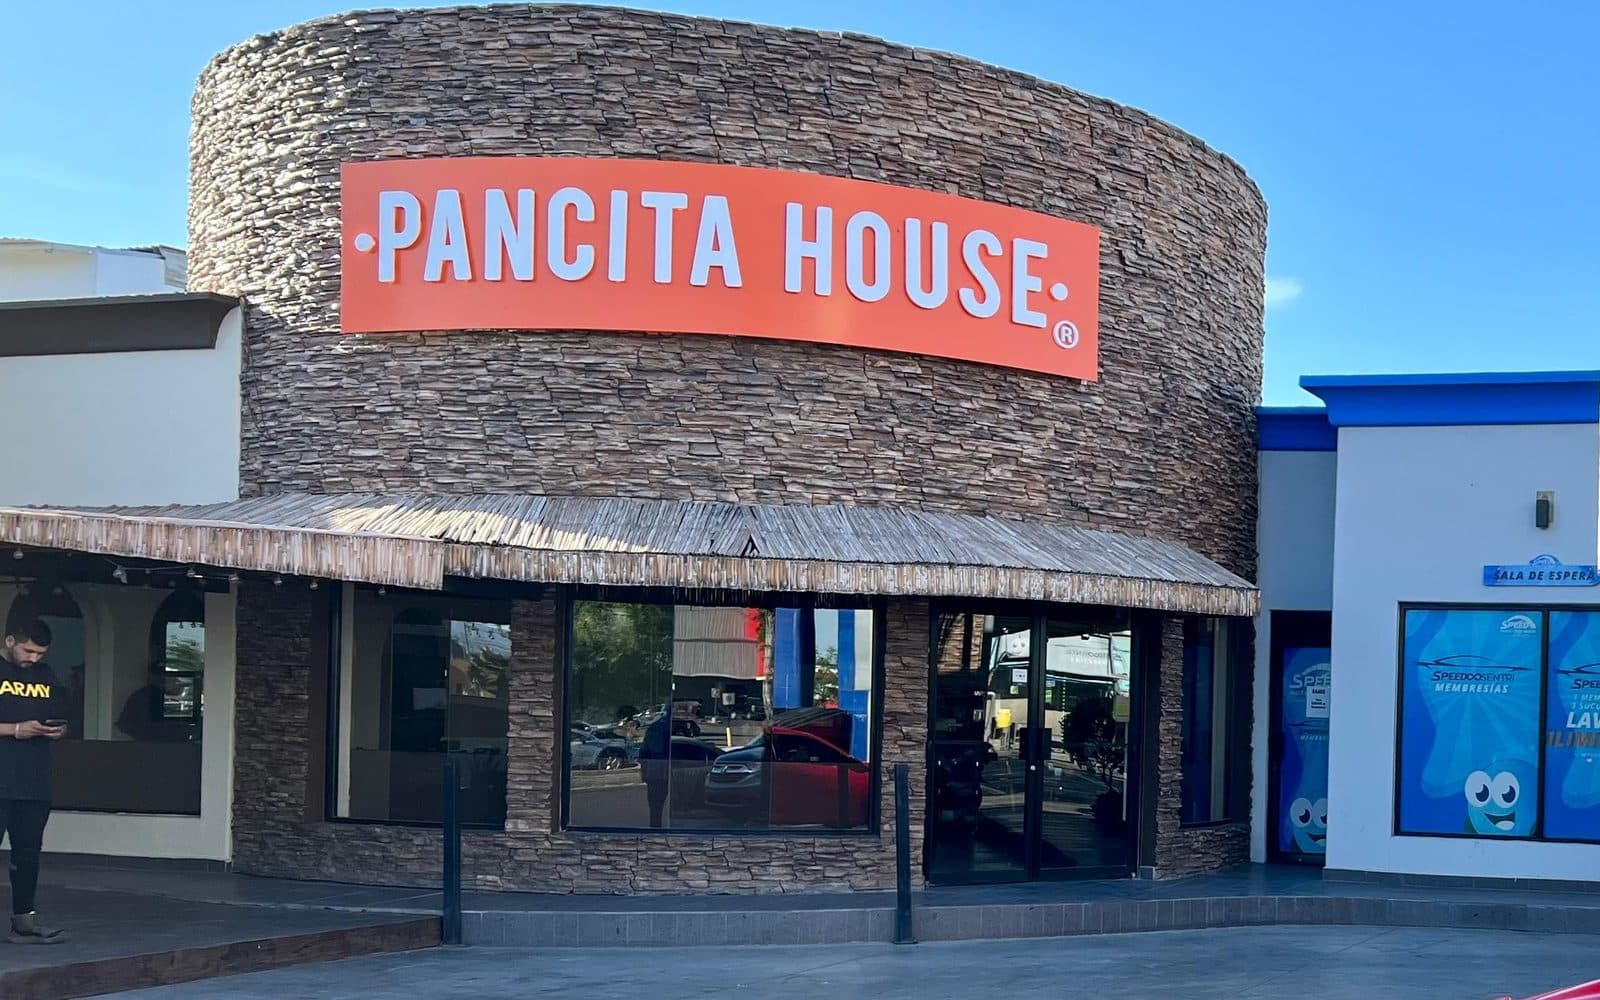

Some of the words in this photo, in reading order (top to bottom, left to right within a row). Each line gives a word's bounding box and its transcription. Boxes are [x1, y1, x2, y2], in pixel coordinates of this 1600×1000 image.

[378, 186, 742, 287] PANCITA
[785, 202, 1048, 328] HOUSE
[1495, 570, 1523, 581] SALA
[1529, 570, 1544, 581] DE
[1548, 570, 1594, 581] ESPERA
[0, 680, 50, 698] ARMY
[1435, 682, 1509, 694] MEMBRESÍAS
